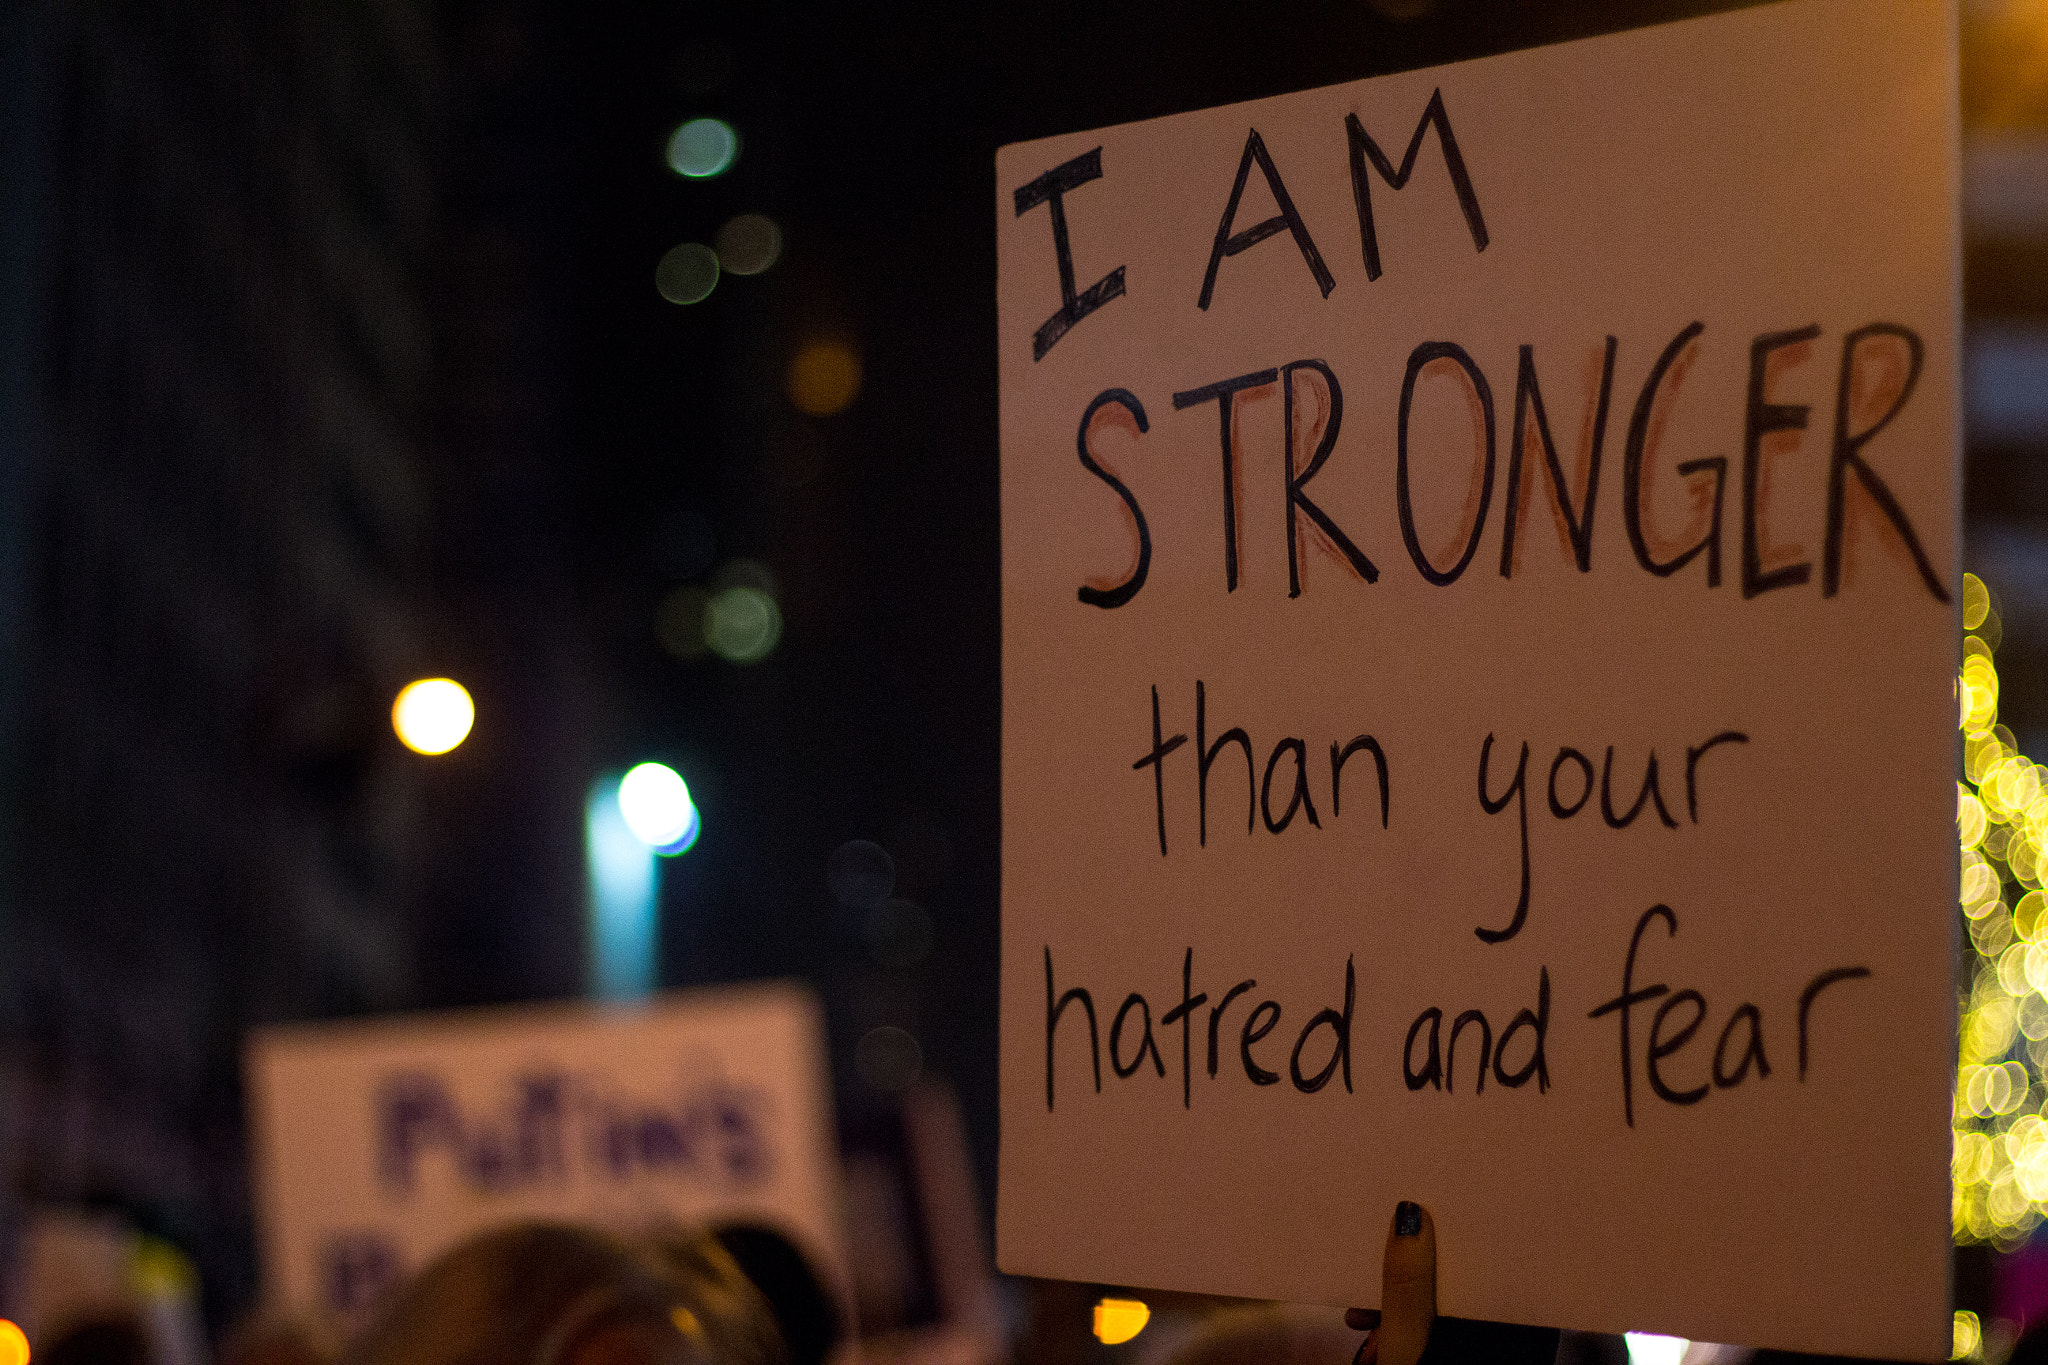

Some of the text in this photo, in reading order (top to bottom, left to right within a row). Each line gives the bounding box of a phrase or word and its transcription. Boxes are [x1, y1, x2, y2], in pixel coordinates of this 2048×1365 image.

[1014, 87, 1490, 362] I AM
[1077, 321, 1953, 609] STRONGER
[1133, 679, 1749, 945] than your
[1043, 903, 1871, 1128] hatred and fear
